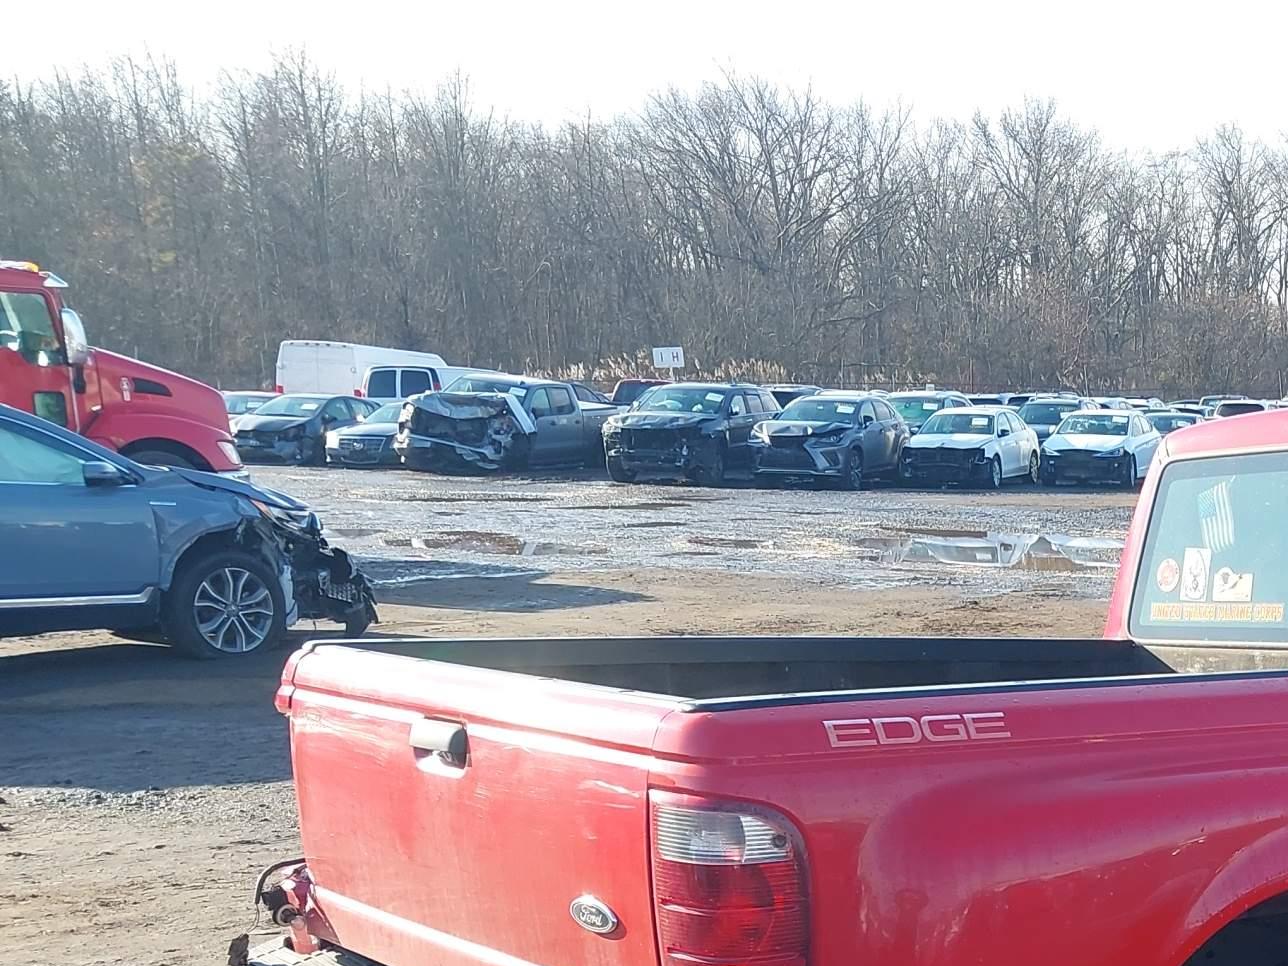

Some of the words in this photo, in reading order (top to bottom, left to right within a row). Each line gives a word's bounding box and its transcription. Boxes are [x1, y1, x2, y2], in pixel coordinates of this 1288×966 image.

[672, 352, 679, 363] H
[822, 712, 1011, 747] EDGE
[580, 904, 602, 925] Ford
